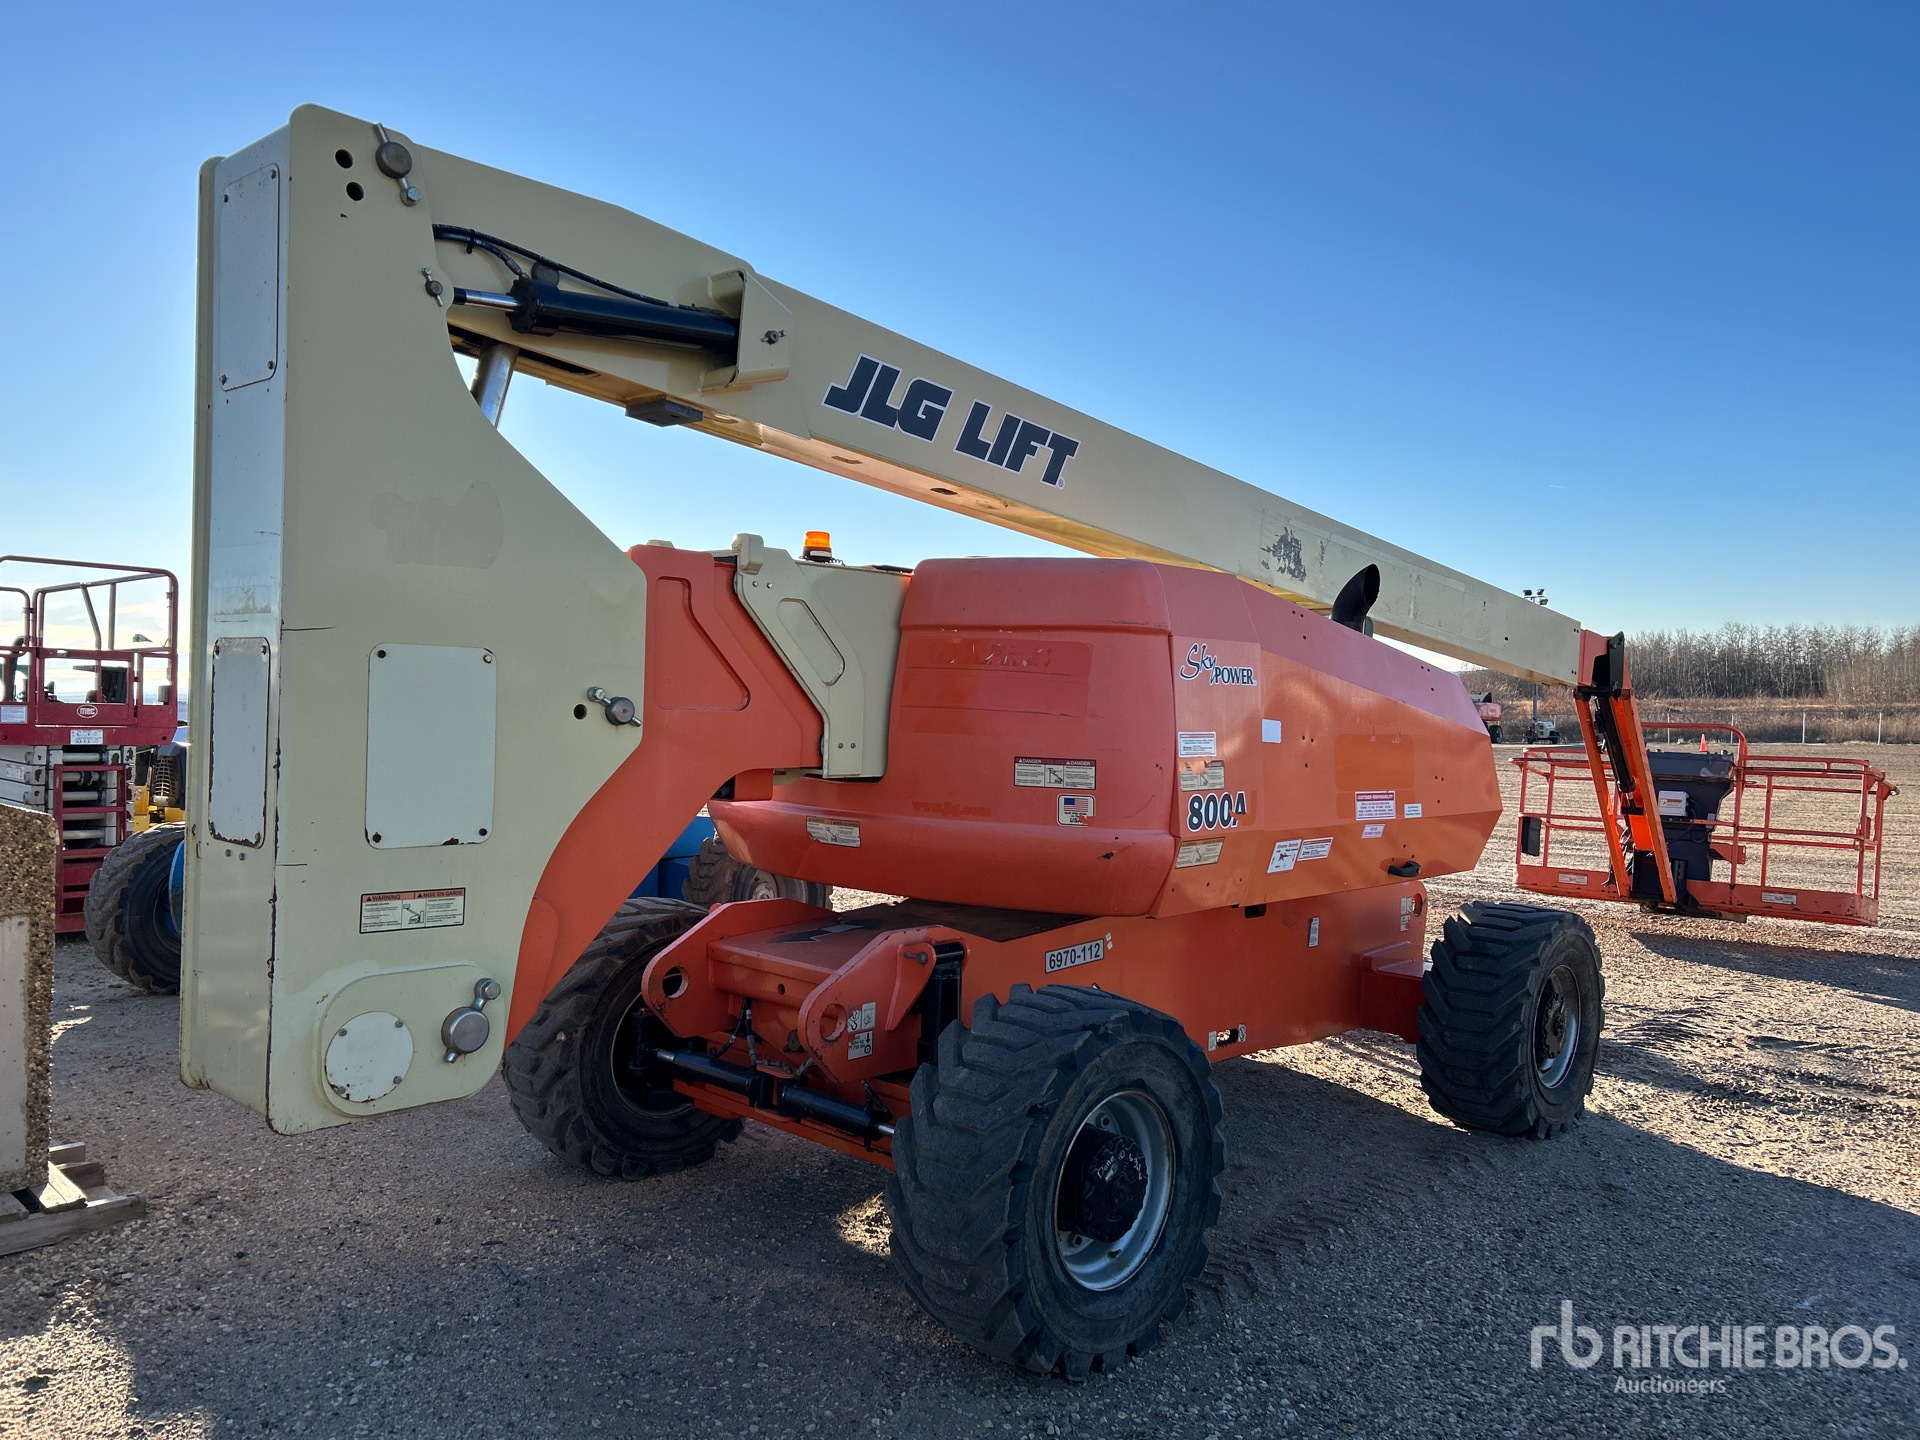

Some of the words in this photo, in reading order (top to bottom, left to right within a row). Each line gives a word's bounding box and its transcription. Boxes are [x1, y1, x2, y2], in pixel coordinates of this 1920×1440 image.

[821, 353, 955, 443] JLG
[953, 398, 1081, 487] LIFT
[1179, 643, 1217, 685] Sky
[1213, 666, 1254, 685] POWER
[1187, 791, 1247, 832] 800A
[1049, 942, 1101, 970] 6970-112
